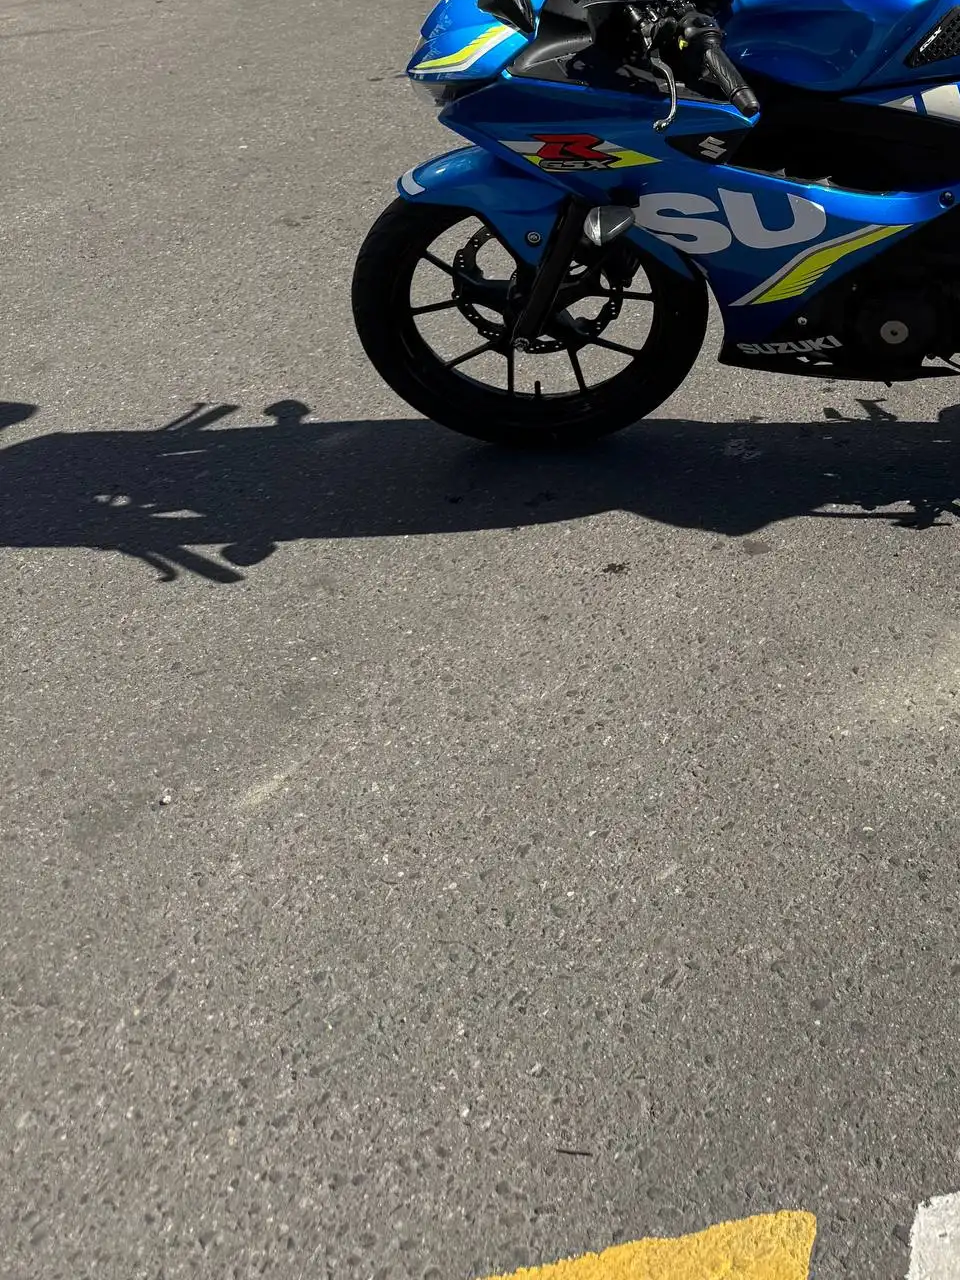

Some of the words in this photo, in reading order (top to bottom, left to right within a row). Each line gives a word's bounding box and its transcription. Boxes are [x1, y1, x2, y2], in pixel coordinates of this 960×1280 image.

[531, 134, 618, 160] R
[539, 160, 611, 170] GSX
[634, 188, 827, 255] SU
[736, 334, 845, 355] SUZUKI
